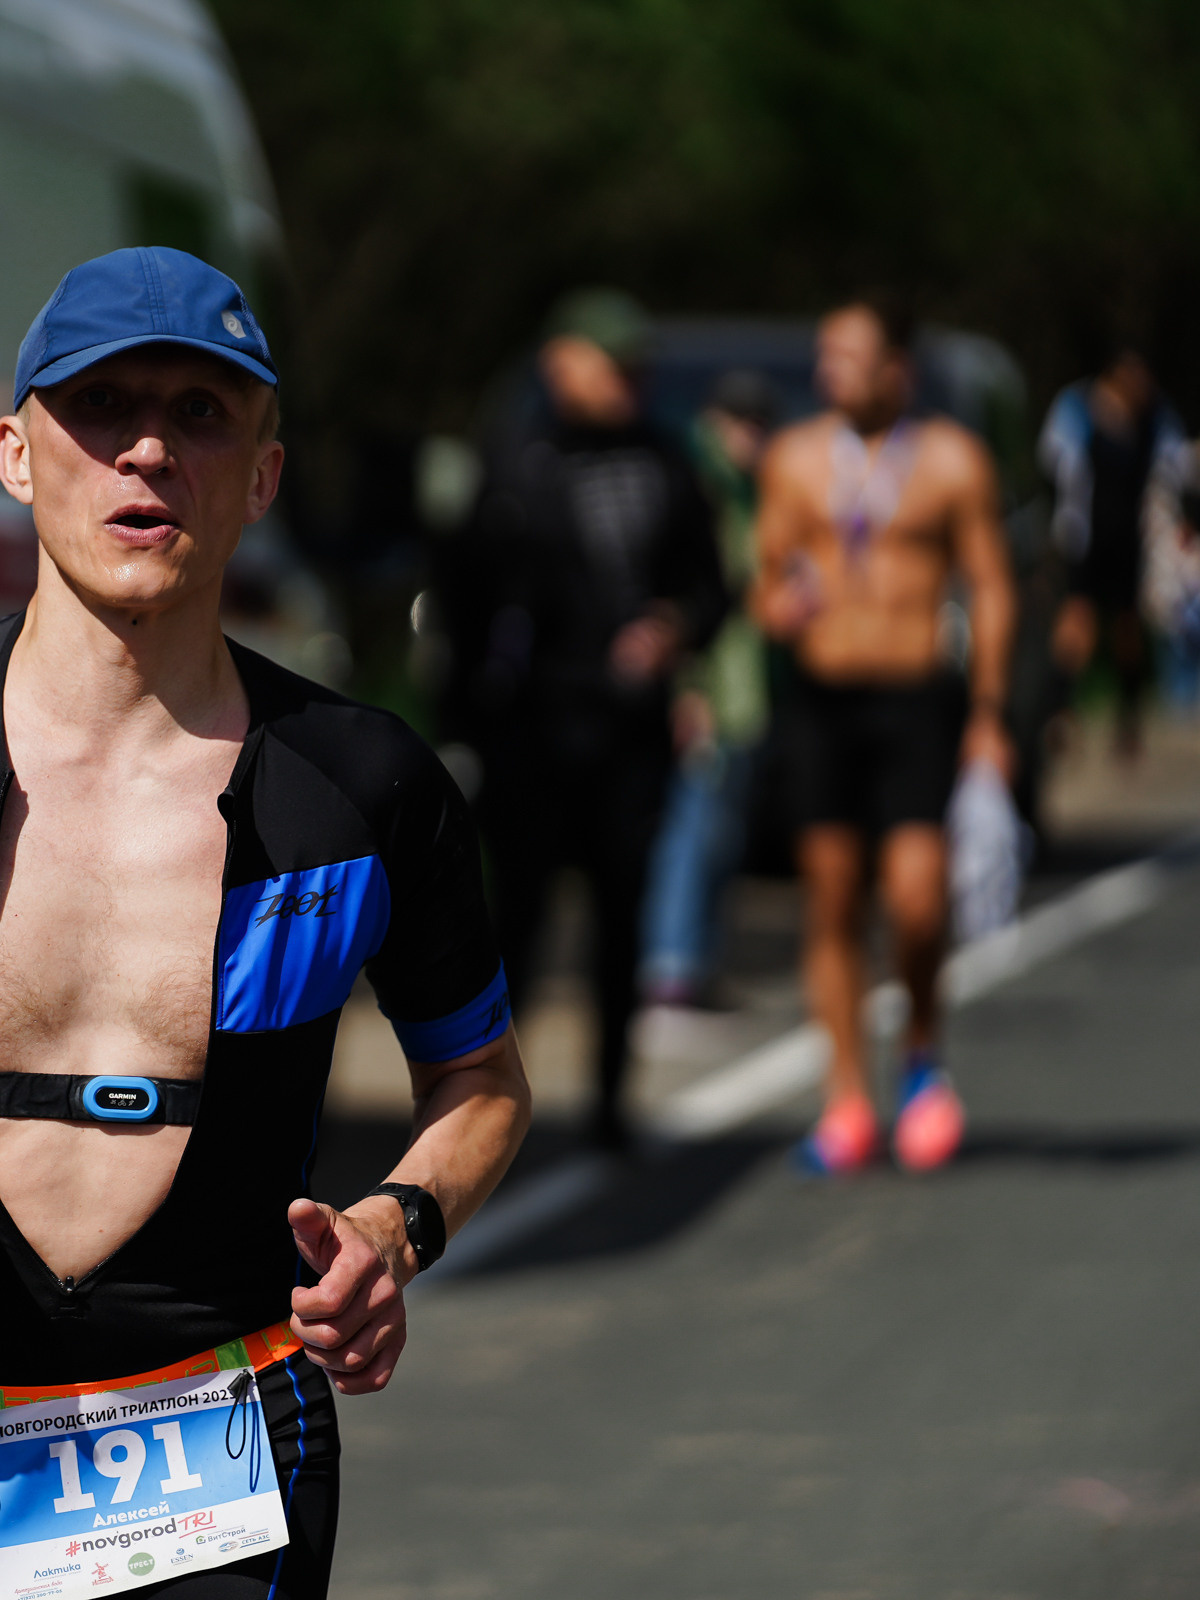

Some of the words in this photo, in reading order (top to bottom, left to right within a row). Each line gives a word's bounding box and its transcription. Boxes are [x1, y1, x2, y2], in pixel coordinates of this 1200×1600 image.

[108, 1092, 137, 1100] GARMIN
[119, 1393, 199, 1418] ТРИАТЛОН
[202, 1389, 237, 1403] 202
[49, 1421, 203, 1514] 191
[92, 1500, 170, 1528] Алексей
[207, 1527, 246, 1543] ВитСтрой
[128, 1558, 154, 1570] ТРЕСТ
[170, 1553, 194, 1564] ESSEN
